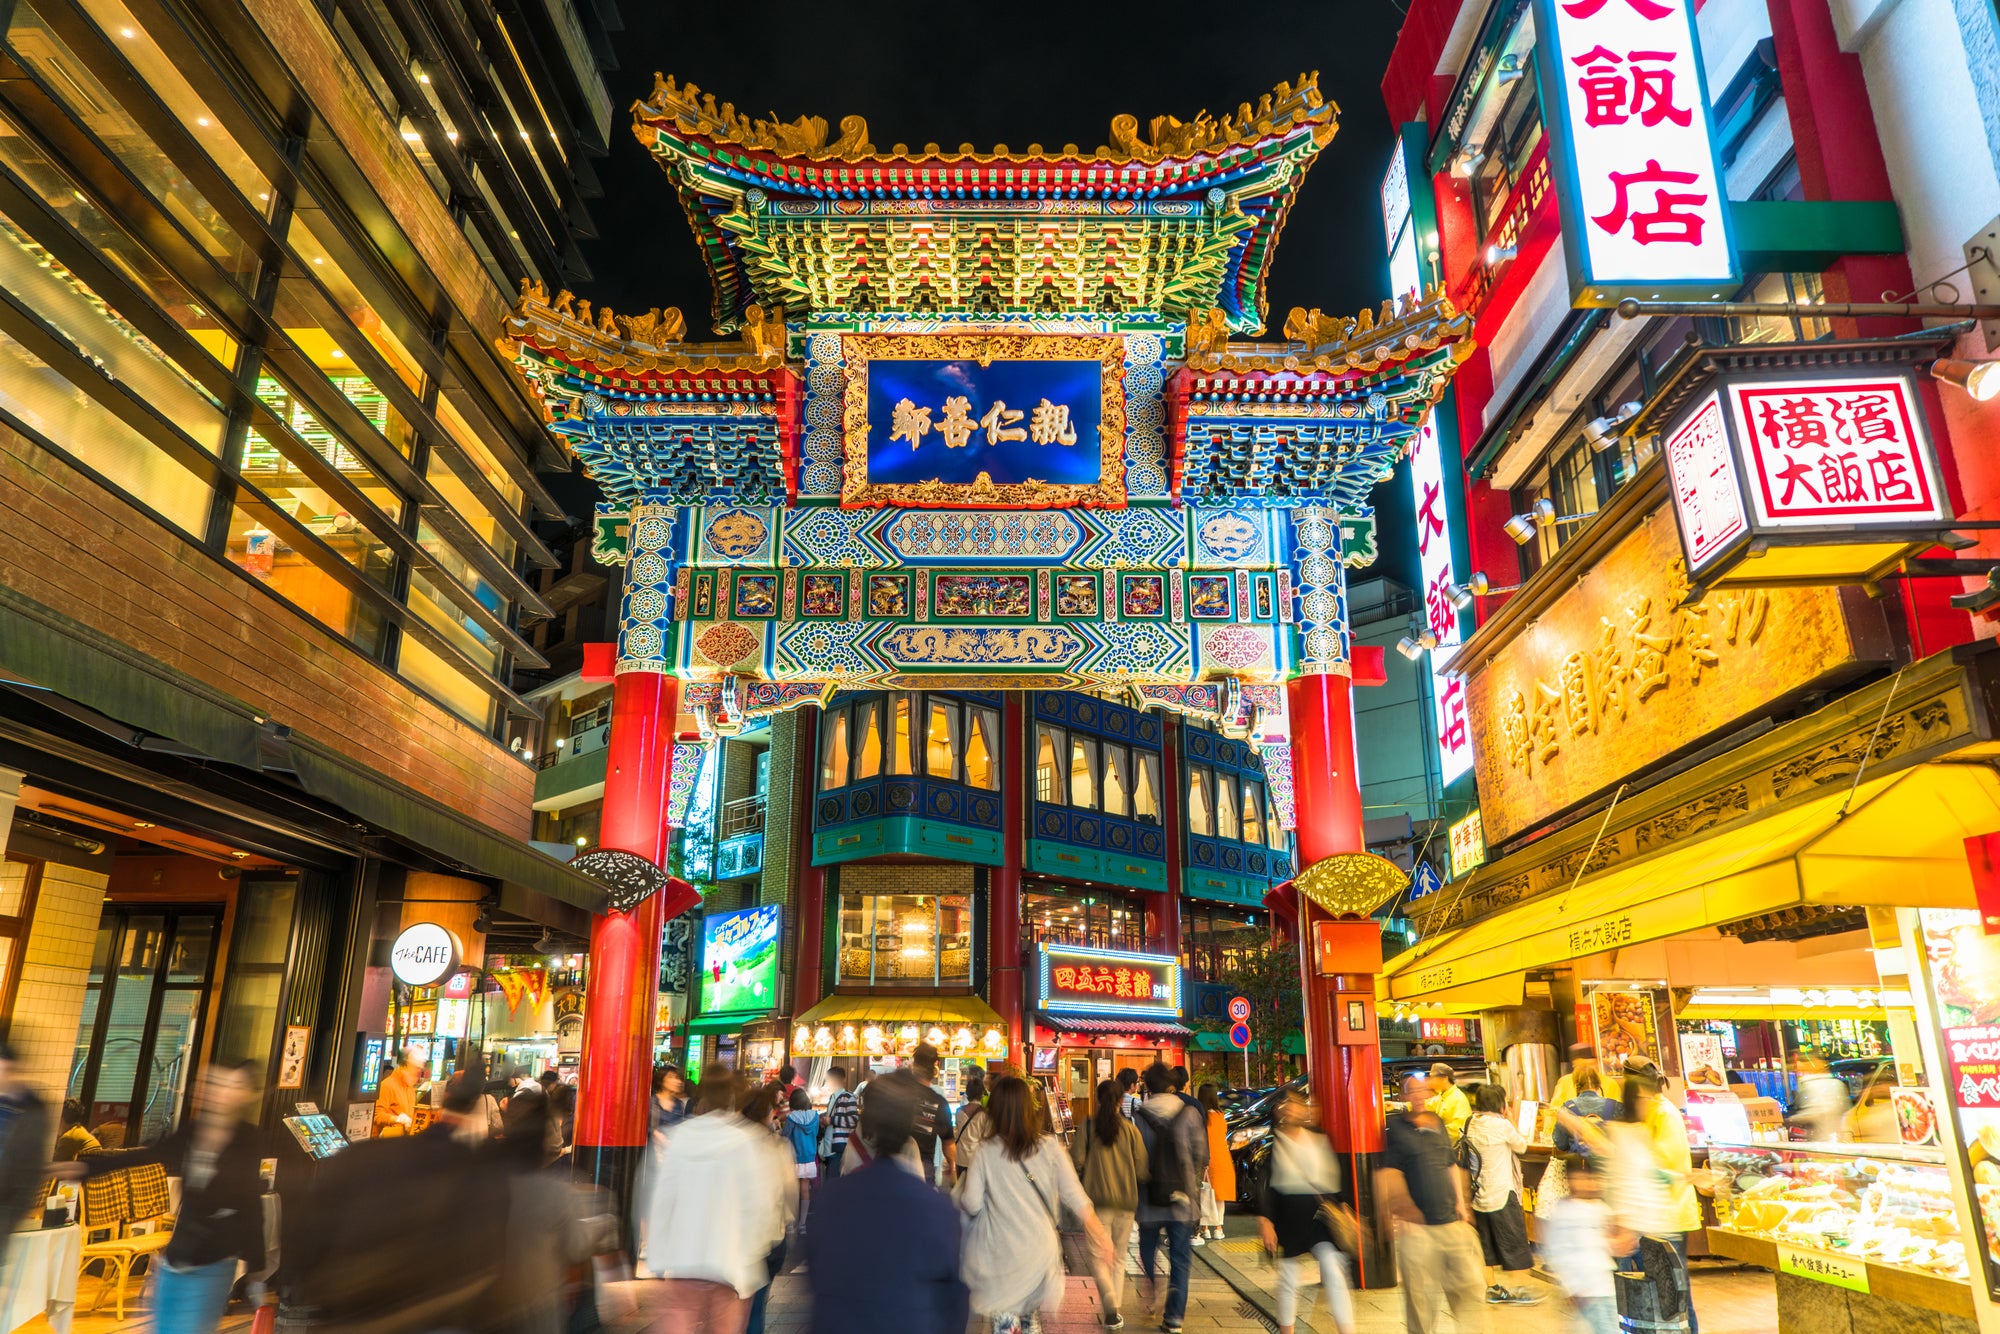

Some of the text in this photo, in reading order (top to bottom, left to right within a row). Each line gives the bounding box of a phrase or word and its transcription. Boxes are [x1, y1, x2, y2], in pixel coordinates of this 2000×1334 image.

[1775, 450, 1915, 506] 大飯店
[1454, 819, 1482, 852] 中華街
[395, 945, 448, 964] The CAFE
[1055, 966, 1151, 998] 四五六菜館
[1233, 1004, 1246, 1016] 30
[1959, 1074, 2000, 1104] 食べ
[1790, 1253, 1856, 1280] 食べ放題メニュー
